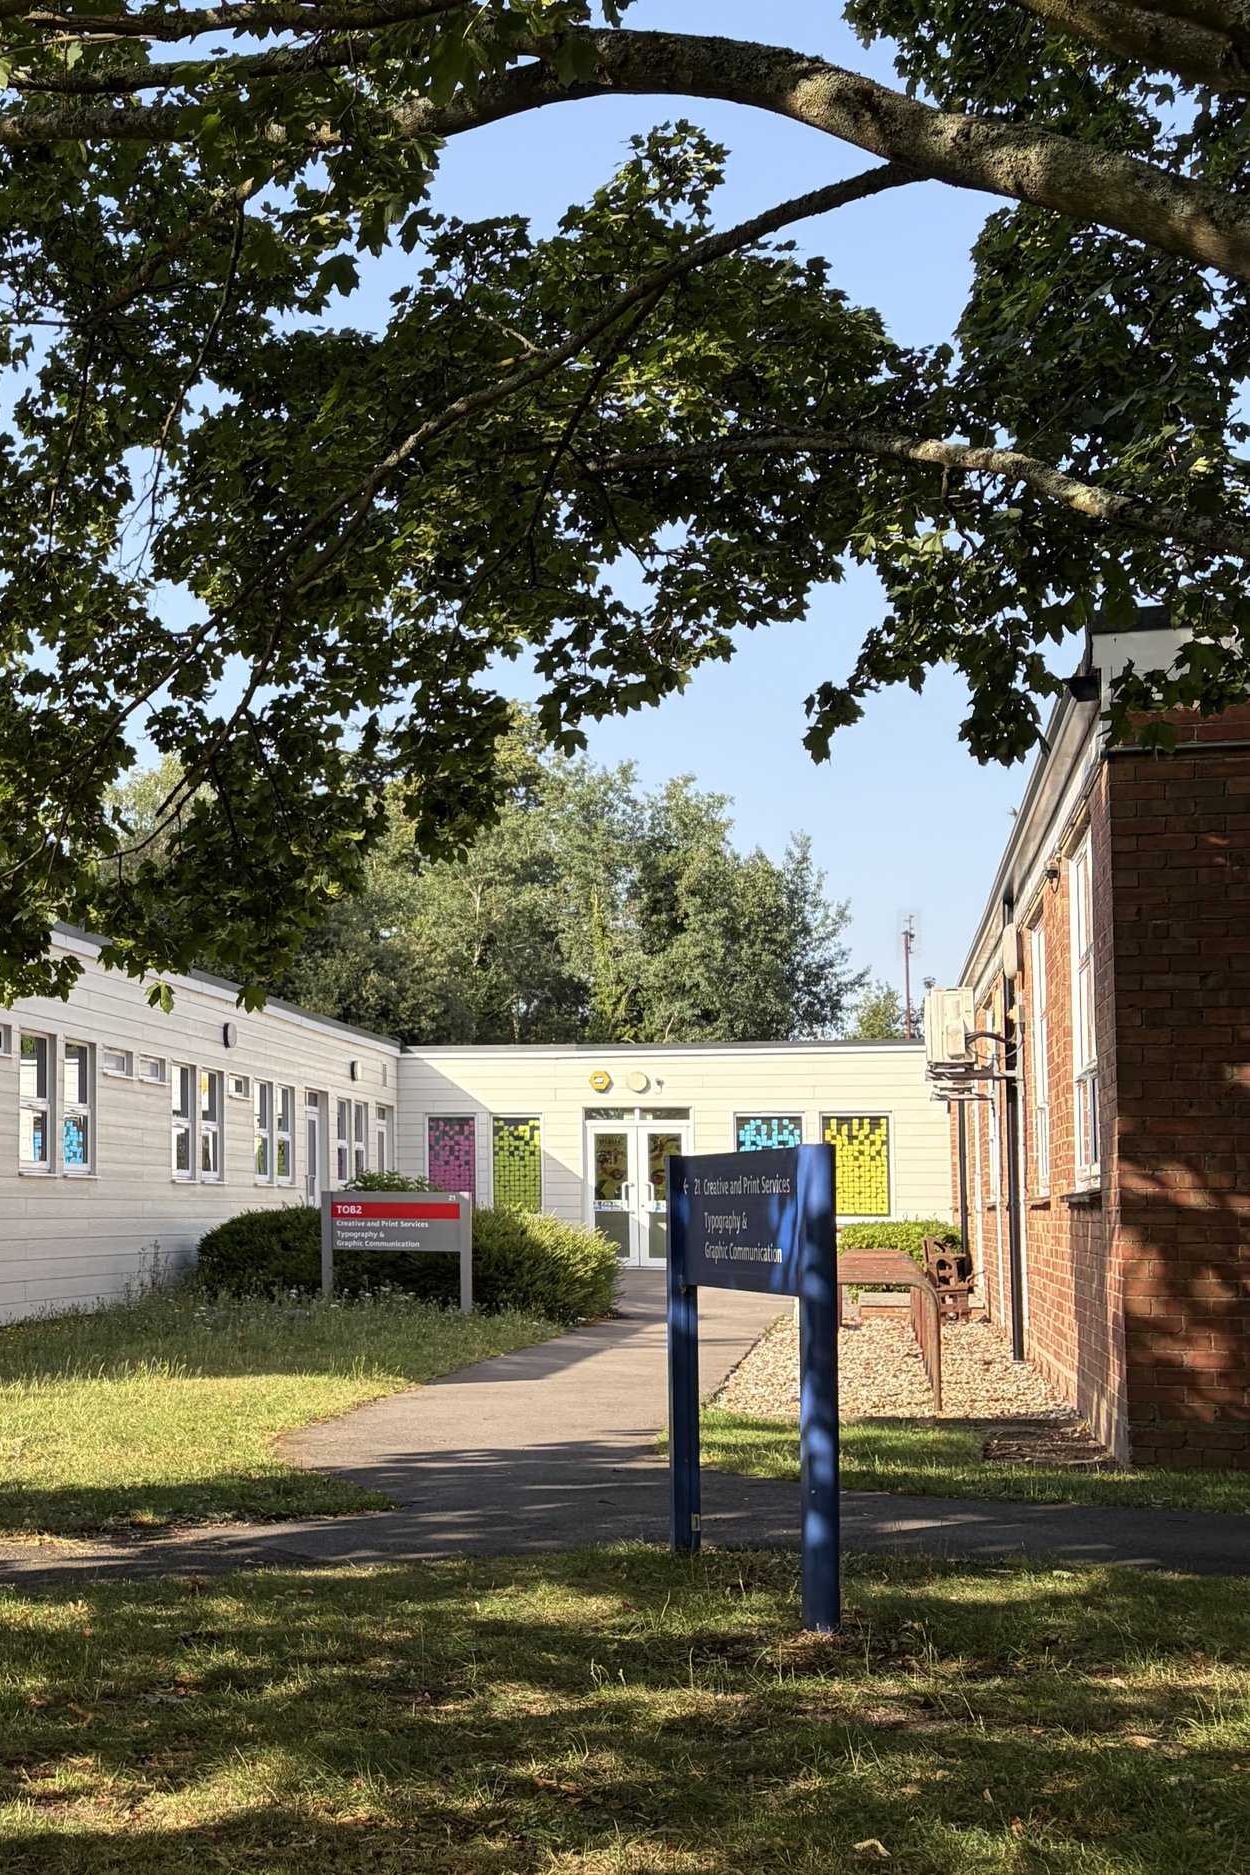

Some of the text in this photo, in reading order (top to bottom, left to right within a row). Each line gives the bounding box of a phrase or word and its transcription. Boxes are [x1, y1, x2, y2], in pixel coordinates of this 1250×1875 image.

[694, 1174, 790, 1195] 21 Creative and Print Services
[337, 1205, 362, 1214] TOB2
[366, 1220, 380, 1228] and
[381, 1220, 399, 1228] Print
[400, 1220, 429, 1228] Services
[704, 1211, 748, 1234] Typography &
[337, 1231, 378, 1239] Typography
[337, 1240, 420, 1248] Graphic Communication
[704, 1241, 783, 1264] Graphic Communication
